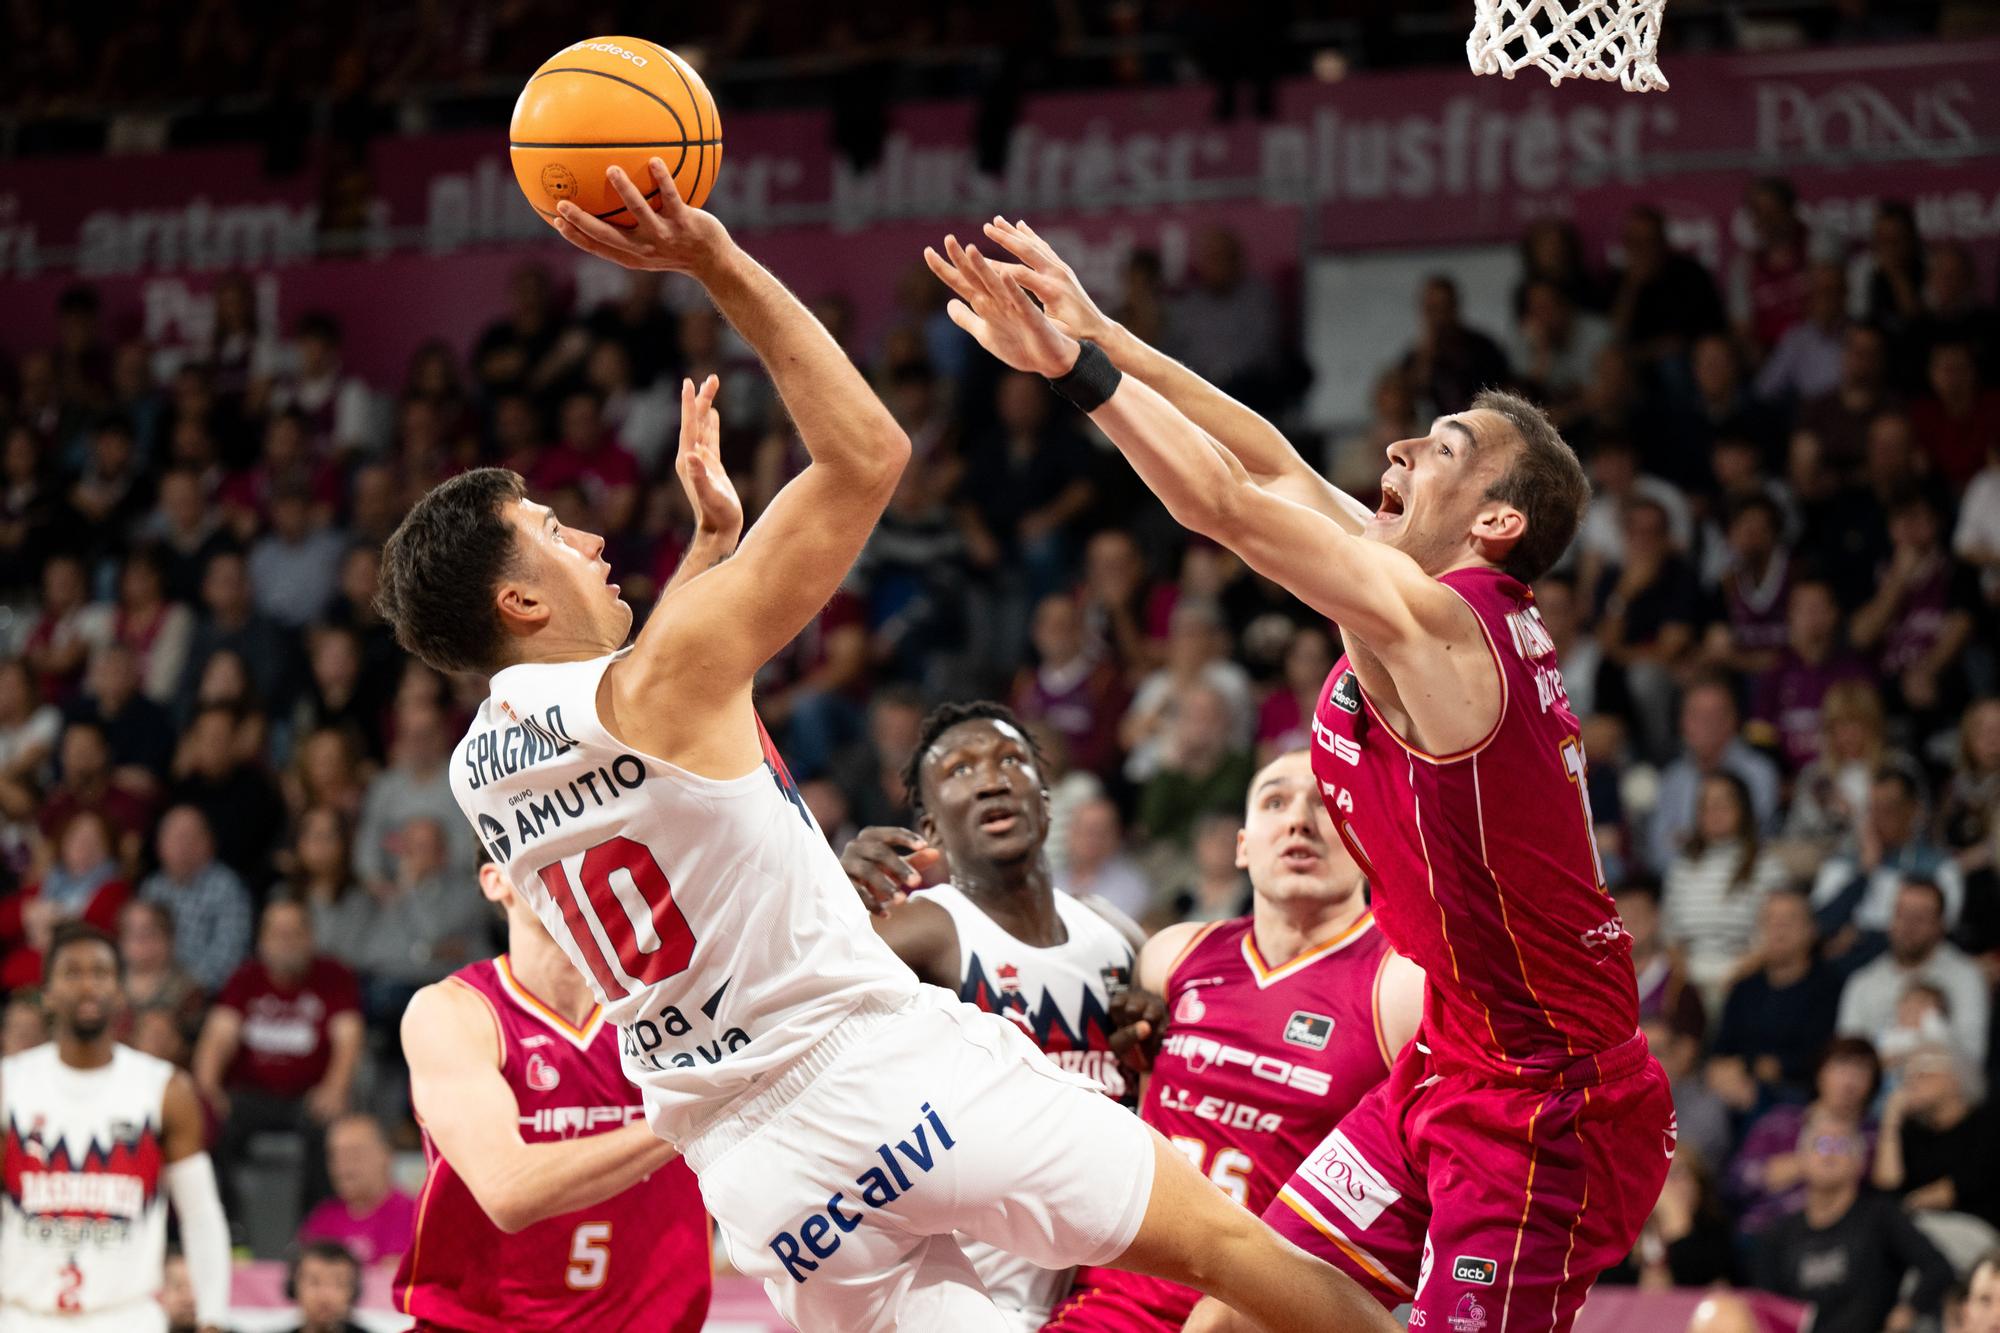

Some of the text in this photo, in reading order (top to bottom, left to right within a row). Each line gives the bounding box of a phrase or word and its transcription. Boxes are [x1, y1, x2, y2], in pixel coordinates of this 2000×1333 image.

[1754, 81, 1980, 170] PONS
[508, 789, 534, 807] GRUPO
[516, 753, 647, 845] AMUTIO
[536, 834, 698, 1002] 10
[1159, 1084, 1284, 1134] LLEIDA
[768, 1101, 957, 1284] Recalvi
[1314, 1147, 1372, 1202] PONS
[565, 1221, 613, 1291] 5
[1457, 1266, 1486, 1281] acb
[56, 1261, 84, 1316] 2
